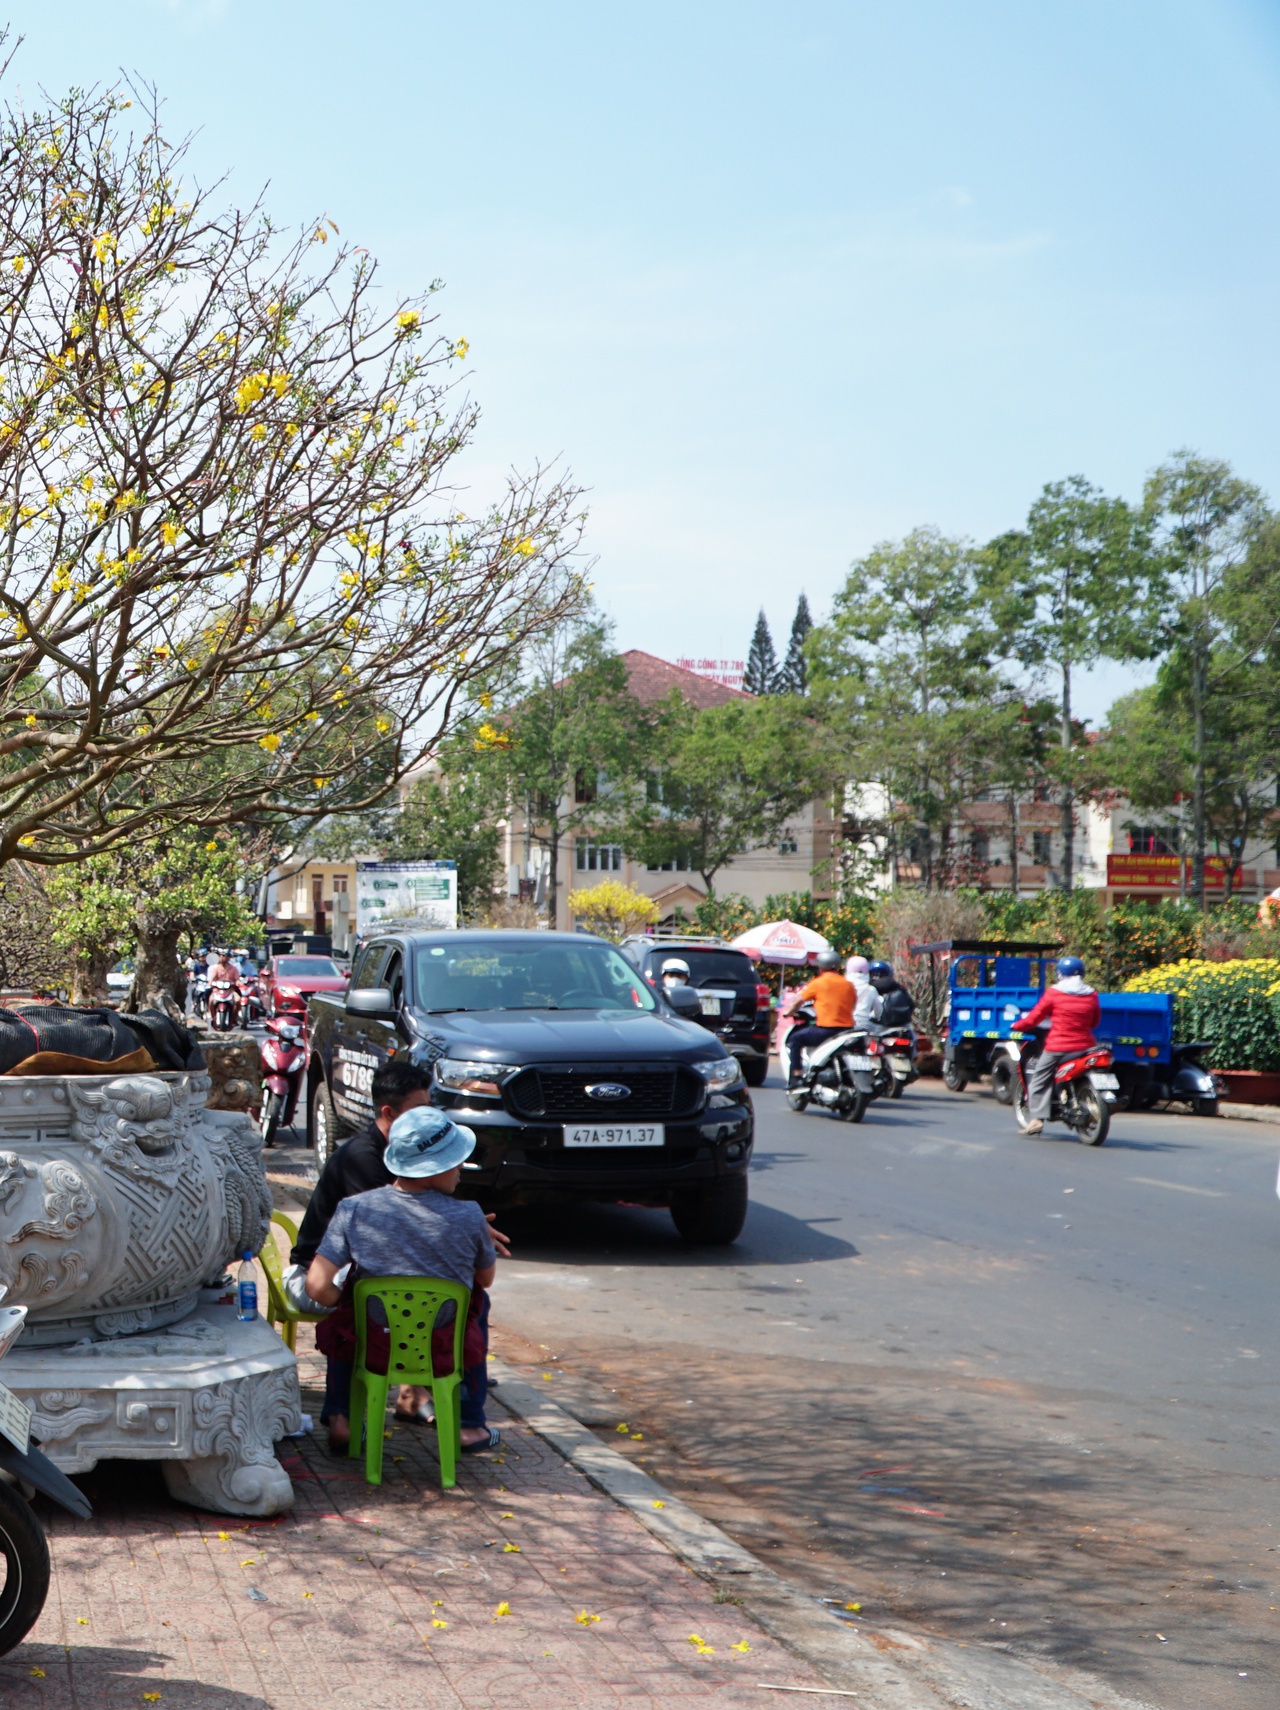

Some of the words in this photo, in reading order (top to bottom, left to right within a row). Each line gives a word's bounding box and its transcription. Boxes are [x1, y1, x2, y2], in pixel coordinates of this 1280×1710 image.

[720, 659, 729, 670] TY
[342, 1062, 375, 1093] 6789
[597, 1086, 622, 1098] Ford
[573, 1128, 655, 1144] 47A-971.37
[6, 1394, 29, 1447] 113.33
